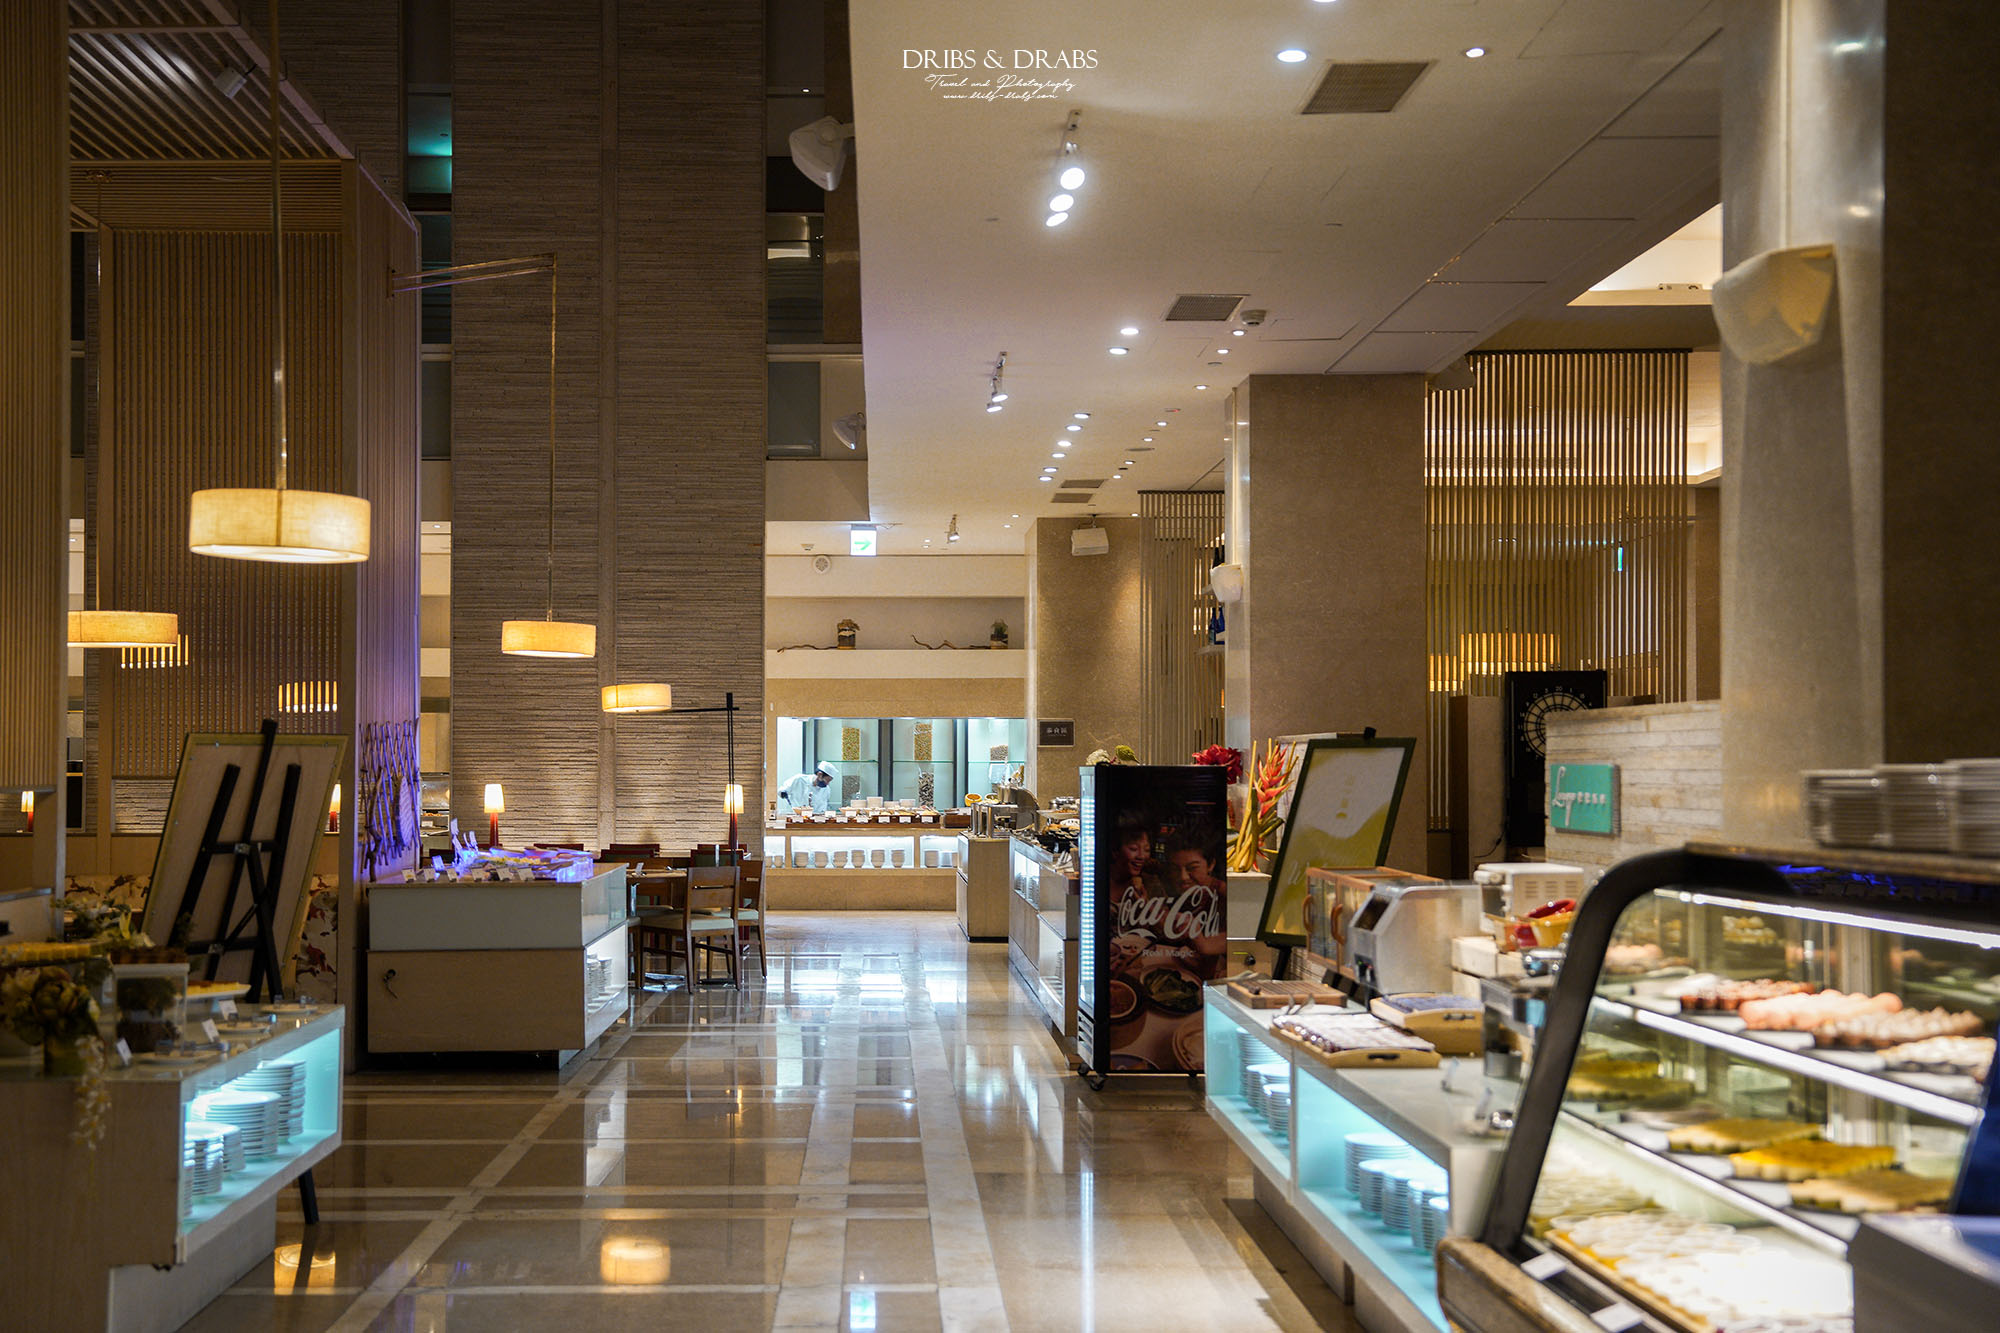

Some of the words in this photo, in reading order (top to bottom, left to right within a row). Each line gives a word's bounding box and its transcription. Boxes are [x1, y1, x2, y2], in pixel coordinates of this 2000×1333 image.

[1117, 885, 1220, 940] Coca-Cola
[1142, 948, 1164, 958] Real
[1166, 948, 1195, 959] Magic
